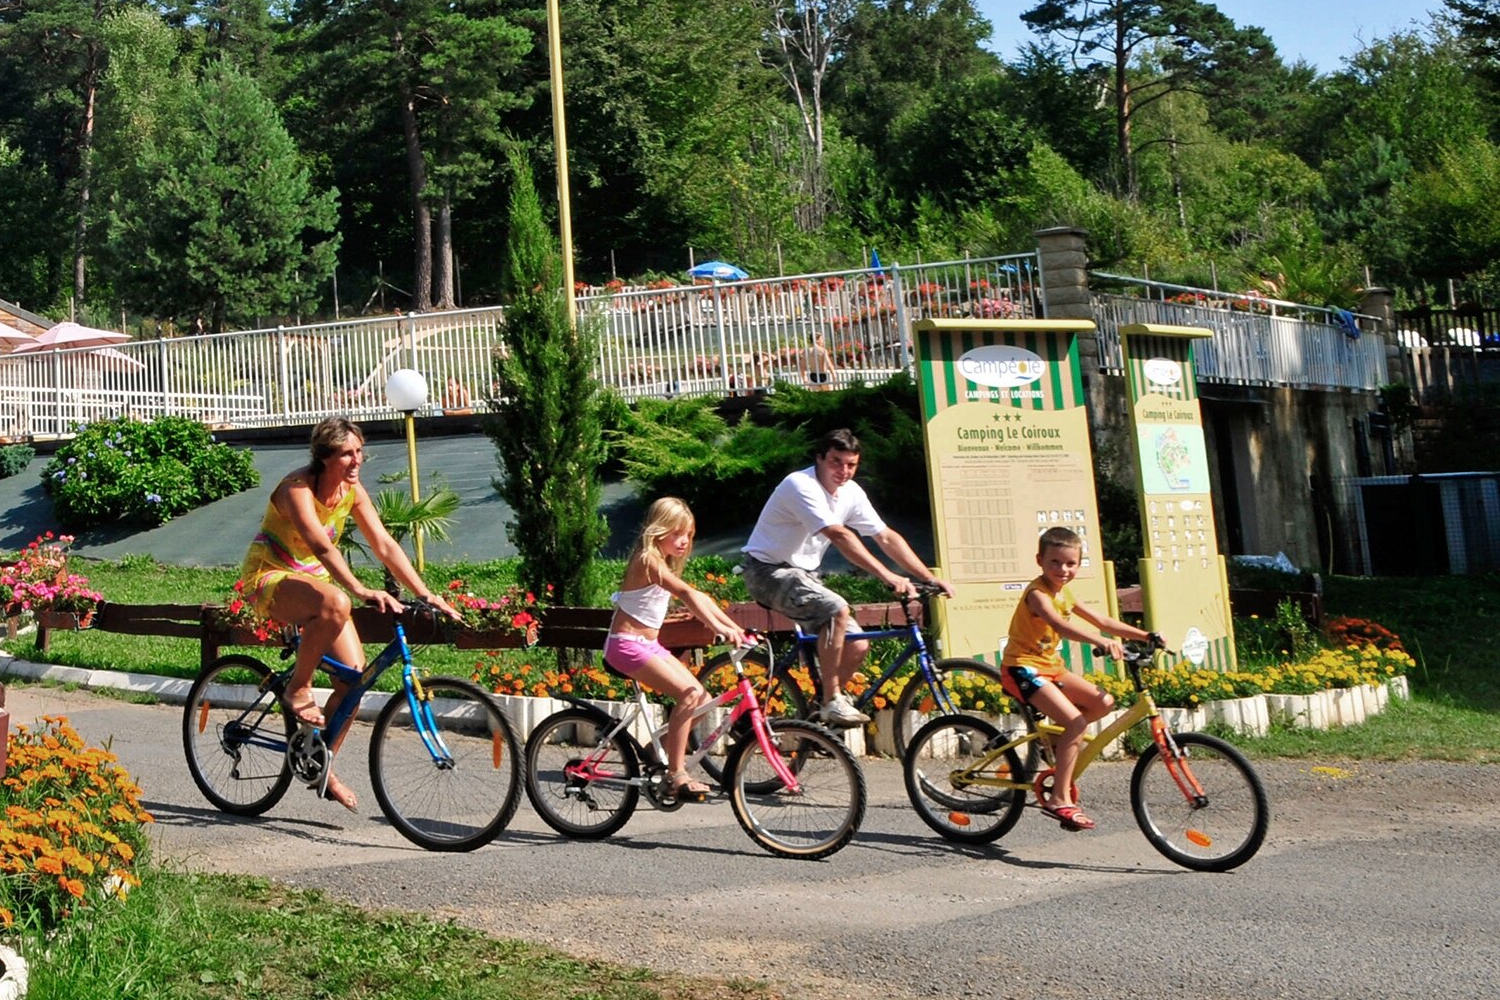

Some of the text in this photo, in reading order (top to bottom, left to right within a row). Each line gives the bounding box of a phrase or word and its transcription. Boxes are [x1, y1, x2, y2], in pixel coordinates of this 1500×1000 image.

[964, 390, 1045, 399] CAMPINGS ET LOCATIONS
[957, 425, 1061, 442] Camping Le Coiroux
[957, 442, 1063, 452] Bienvenue Welcome Willkommen
